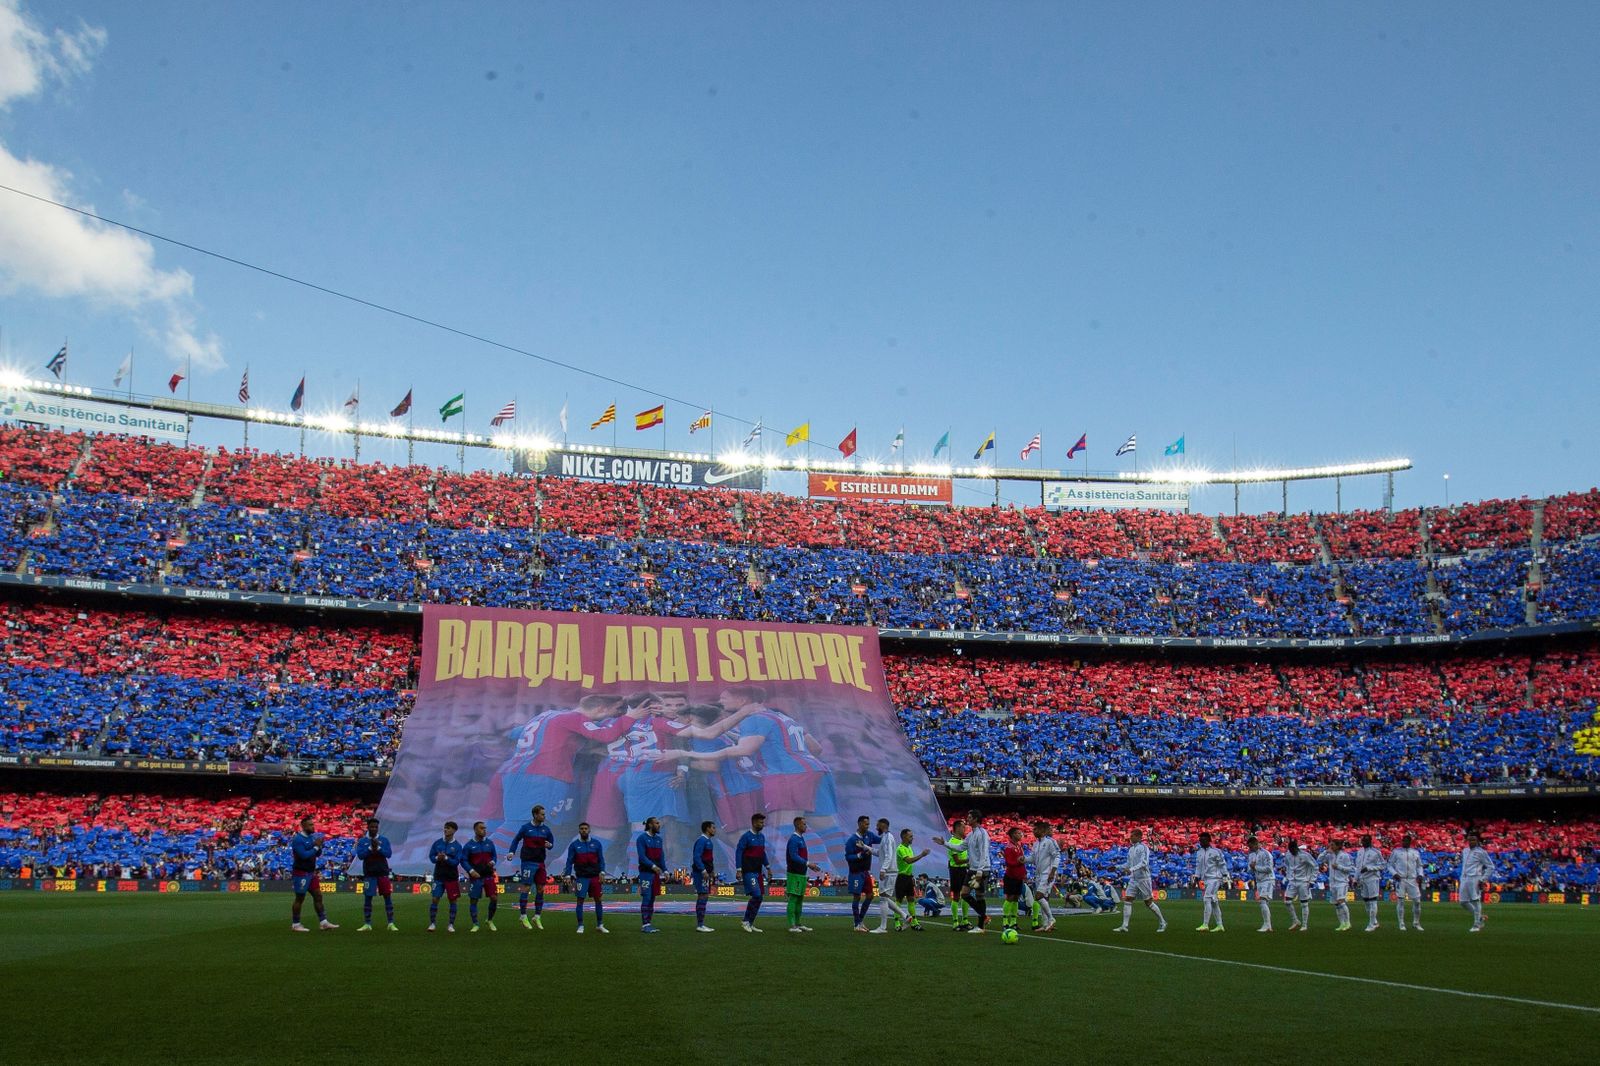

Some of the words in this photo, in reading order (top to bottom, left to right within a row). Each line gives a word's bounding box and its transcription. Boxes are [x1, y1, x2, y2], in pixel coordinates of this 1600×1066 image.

[25, 401, 115, 424] Assistència
[118, 414, 185, 433] Sanitària
[561, 454, 693, 483] NIKE.COM/FCB
[841, 481, 898, 495] ESTRELLA
[901, 484, 938, 496] DAMM
[1067, 488, 1135, 501] Assistència
[1136, 490, 1188, 501] Sanitària
[185, 589, 230, 600] NIKE.COM/FCB
[305, 597, 347, 607] NIKE.COM/FCB
[1024, 634, 1060, 642] NIKE.COM/FCB
[435, 619, 594, 688] BARÇA,
[602, 625, 689, 683] ARA
[692, 627, 713, 682] I
[716, 628, 873, 692] SEMPRE
[523, 869, 531, 877] 21
[301, 879, 307, 887] 9
[641, 880, 650, 889] 22
[751, 878, 756, 886] 3
[854, 879, 859, 888] 5
